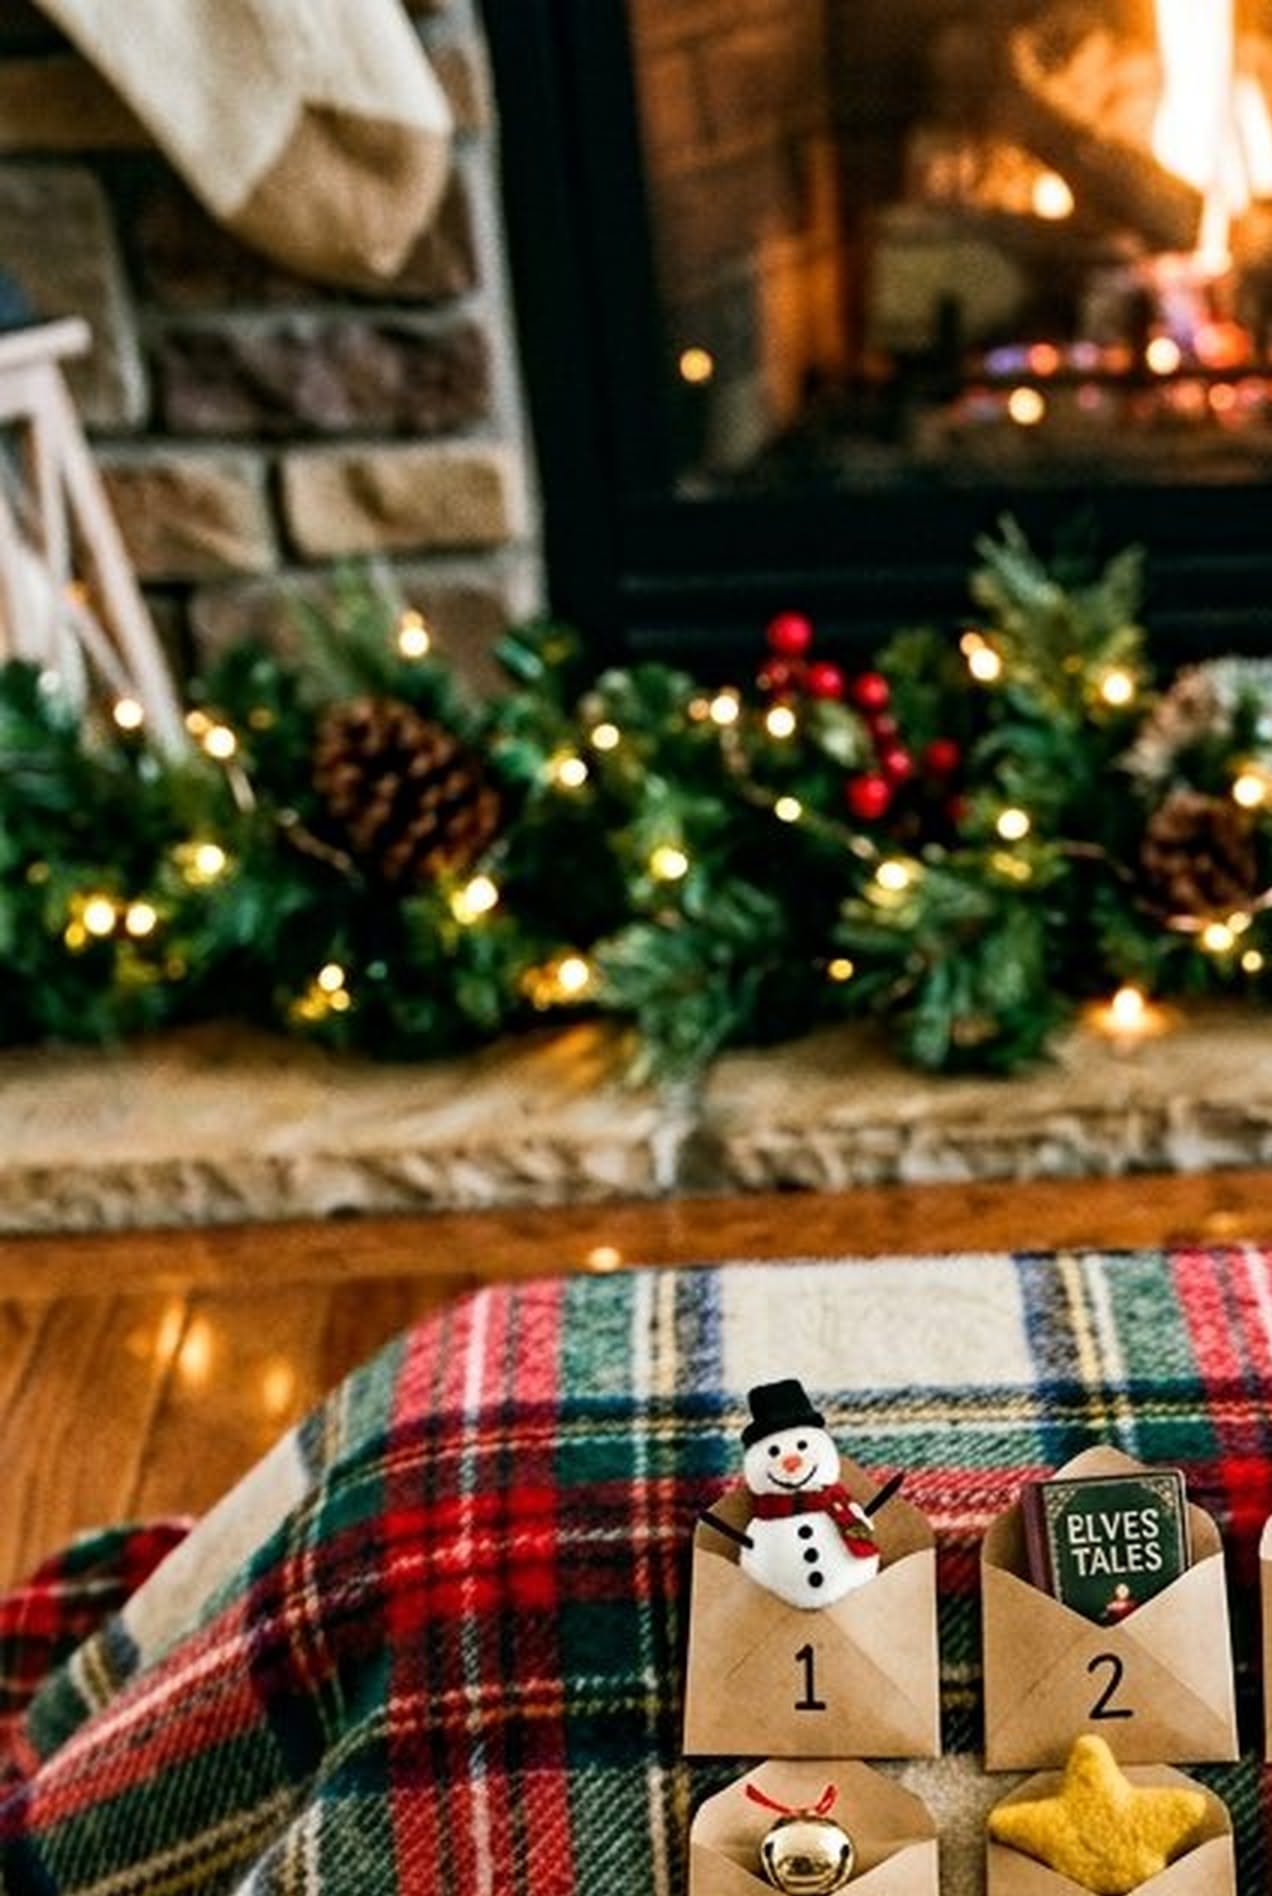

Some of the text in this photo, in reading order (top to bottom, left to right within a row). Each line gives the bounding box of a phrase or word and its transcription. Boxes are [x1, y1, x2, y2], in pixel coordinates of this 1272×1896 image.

[1070, 1542, 1163, 1577] TALES
[793, 1642, 828, 1712] 1
[1086, 1652, 1135, 1722] 2
